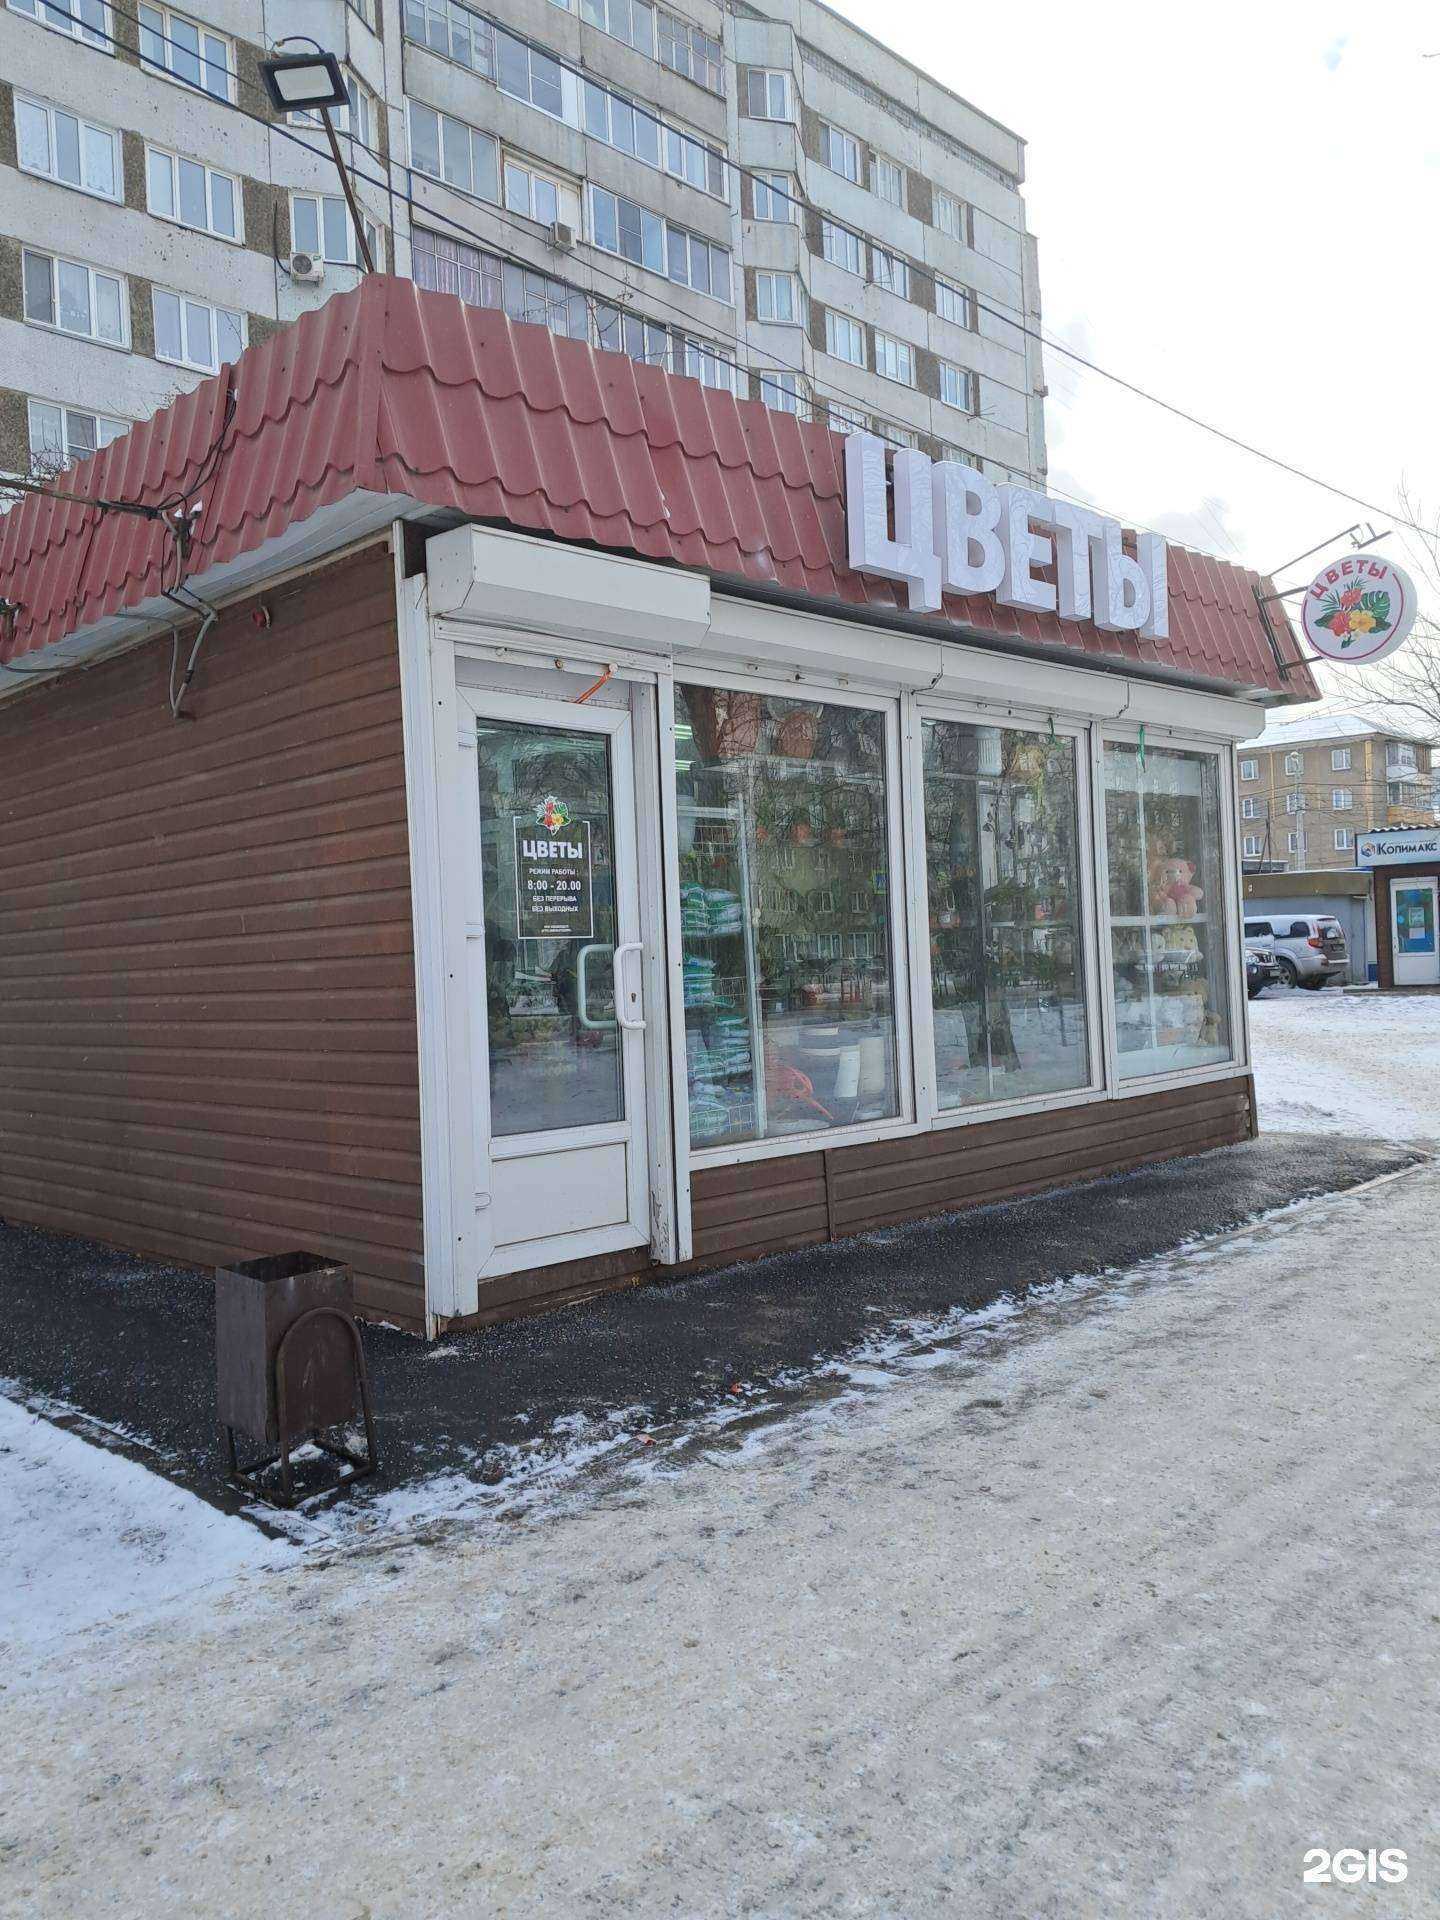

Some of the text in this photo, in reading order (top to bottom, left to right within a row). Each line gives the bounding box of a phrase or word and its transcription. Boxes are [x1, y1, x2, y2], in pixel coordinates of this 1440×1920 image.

[845, 432, 1169, 640] ЦВЕТЫ
[1310, 559, 1388, 599] ЦВЕТЫ
[522, 839, 583, 860] ЦВЕТЫ
[529, 867, 550, 875] РЕЖИМ
[527, 879, 548, 890] 8:00
[556, 880, 581, 891] 20.00
